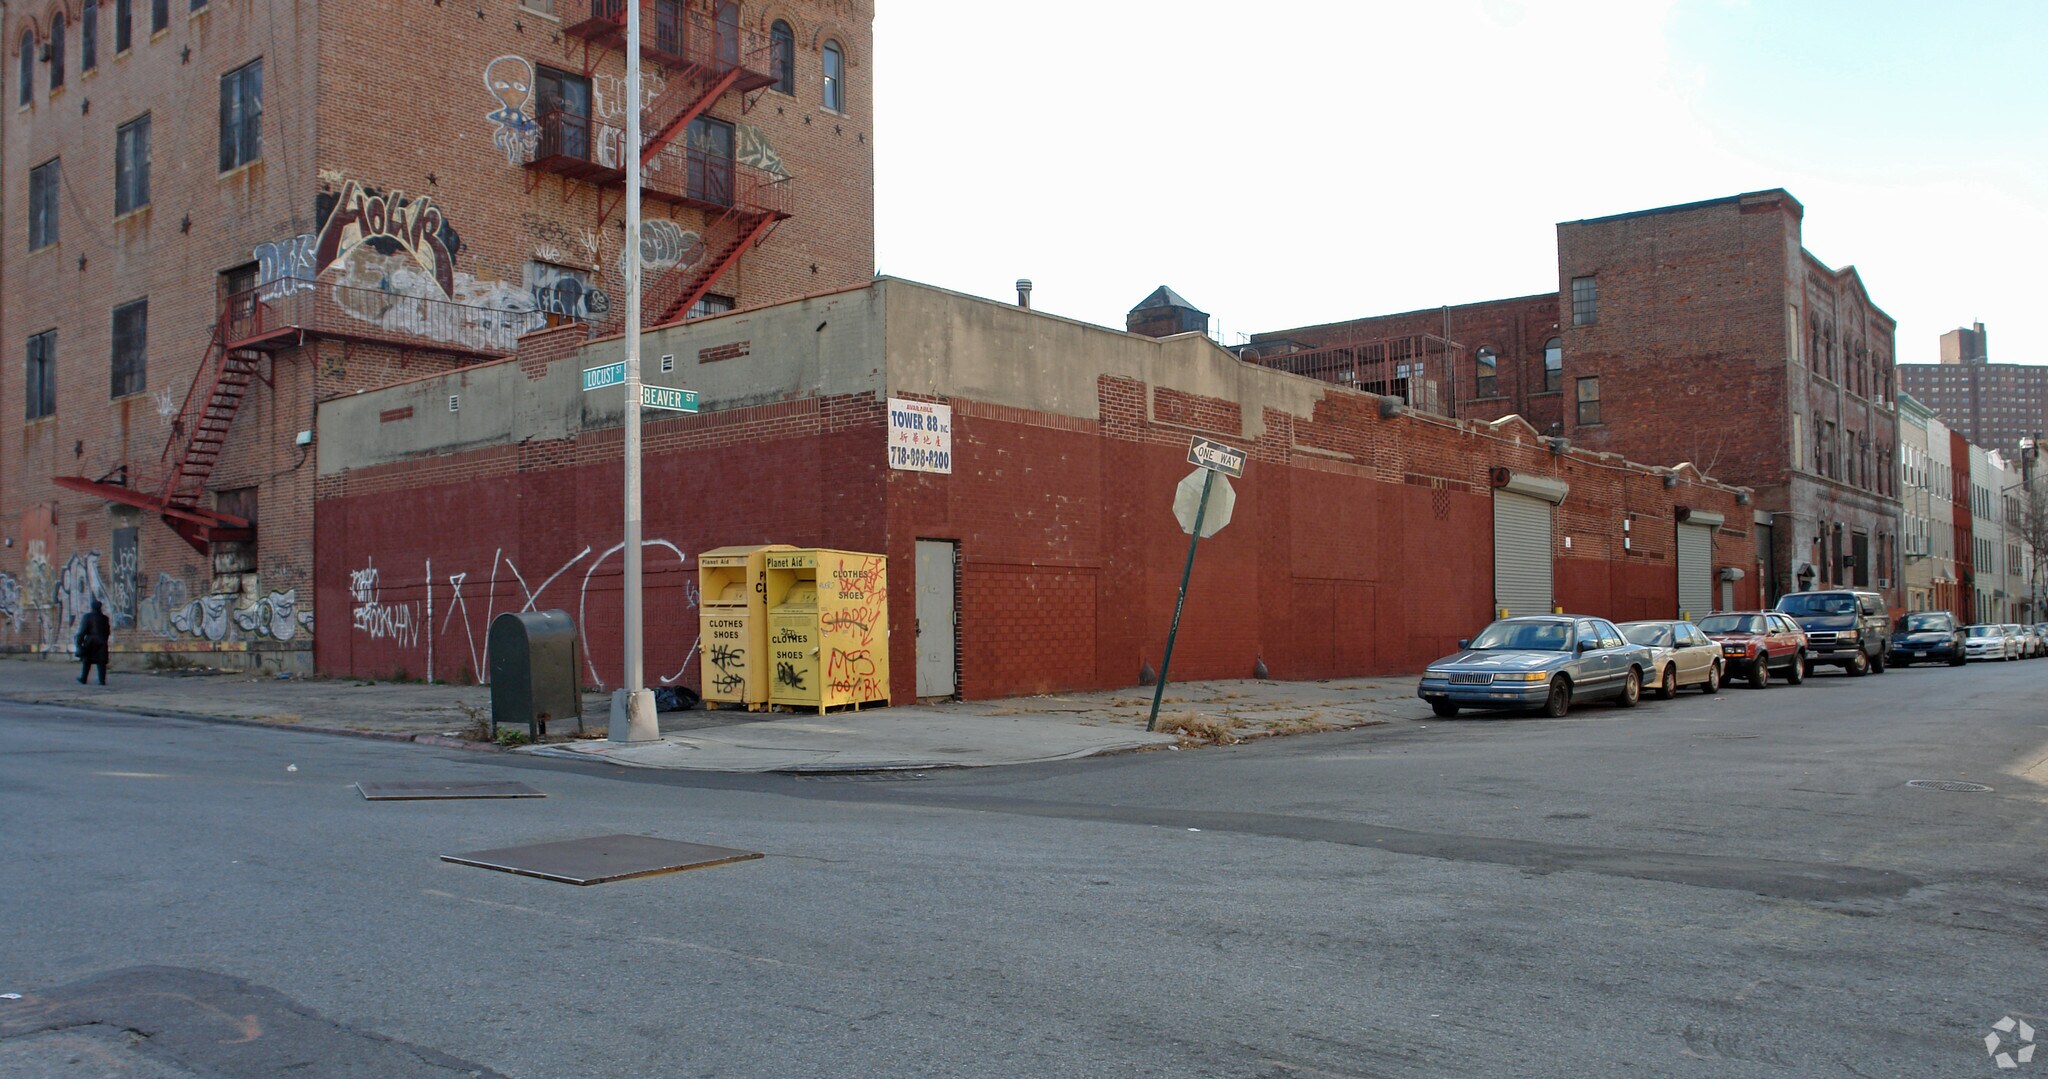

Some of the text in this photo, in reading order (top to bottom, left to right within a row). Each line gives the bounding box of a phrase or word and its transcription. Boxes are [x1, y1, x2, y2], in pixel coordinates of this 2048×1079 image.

[587, 365, 622, 387] LOCUST ST
[644, 388, 695, 408] BEAVER ST
[891, 410, 924, 430] TOWER
[926, 415, 938, 432] 88
[1198, 446, 1238, 467] ONE WAY
[767, 557, 803, 568] Planet Aid
[832, 570, 868, 578] CLOTHES
[838, 592, 864, 600] SHOES
[709, 620, 743, 628] CLOTHES
[713, 631, 739, 639] SHOES
[772, 635, 808, 643] CLOTHES
[776, 651, 803, 659] SHOES
